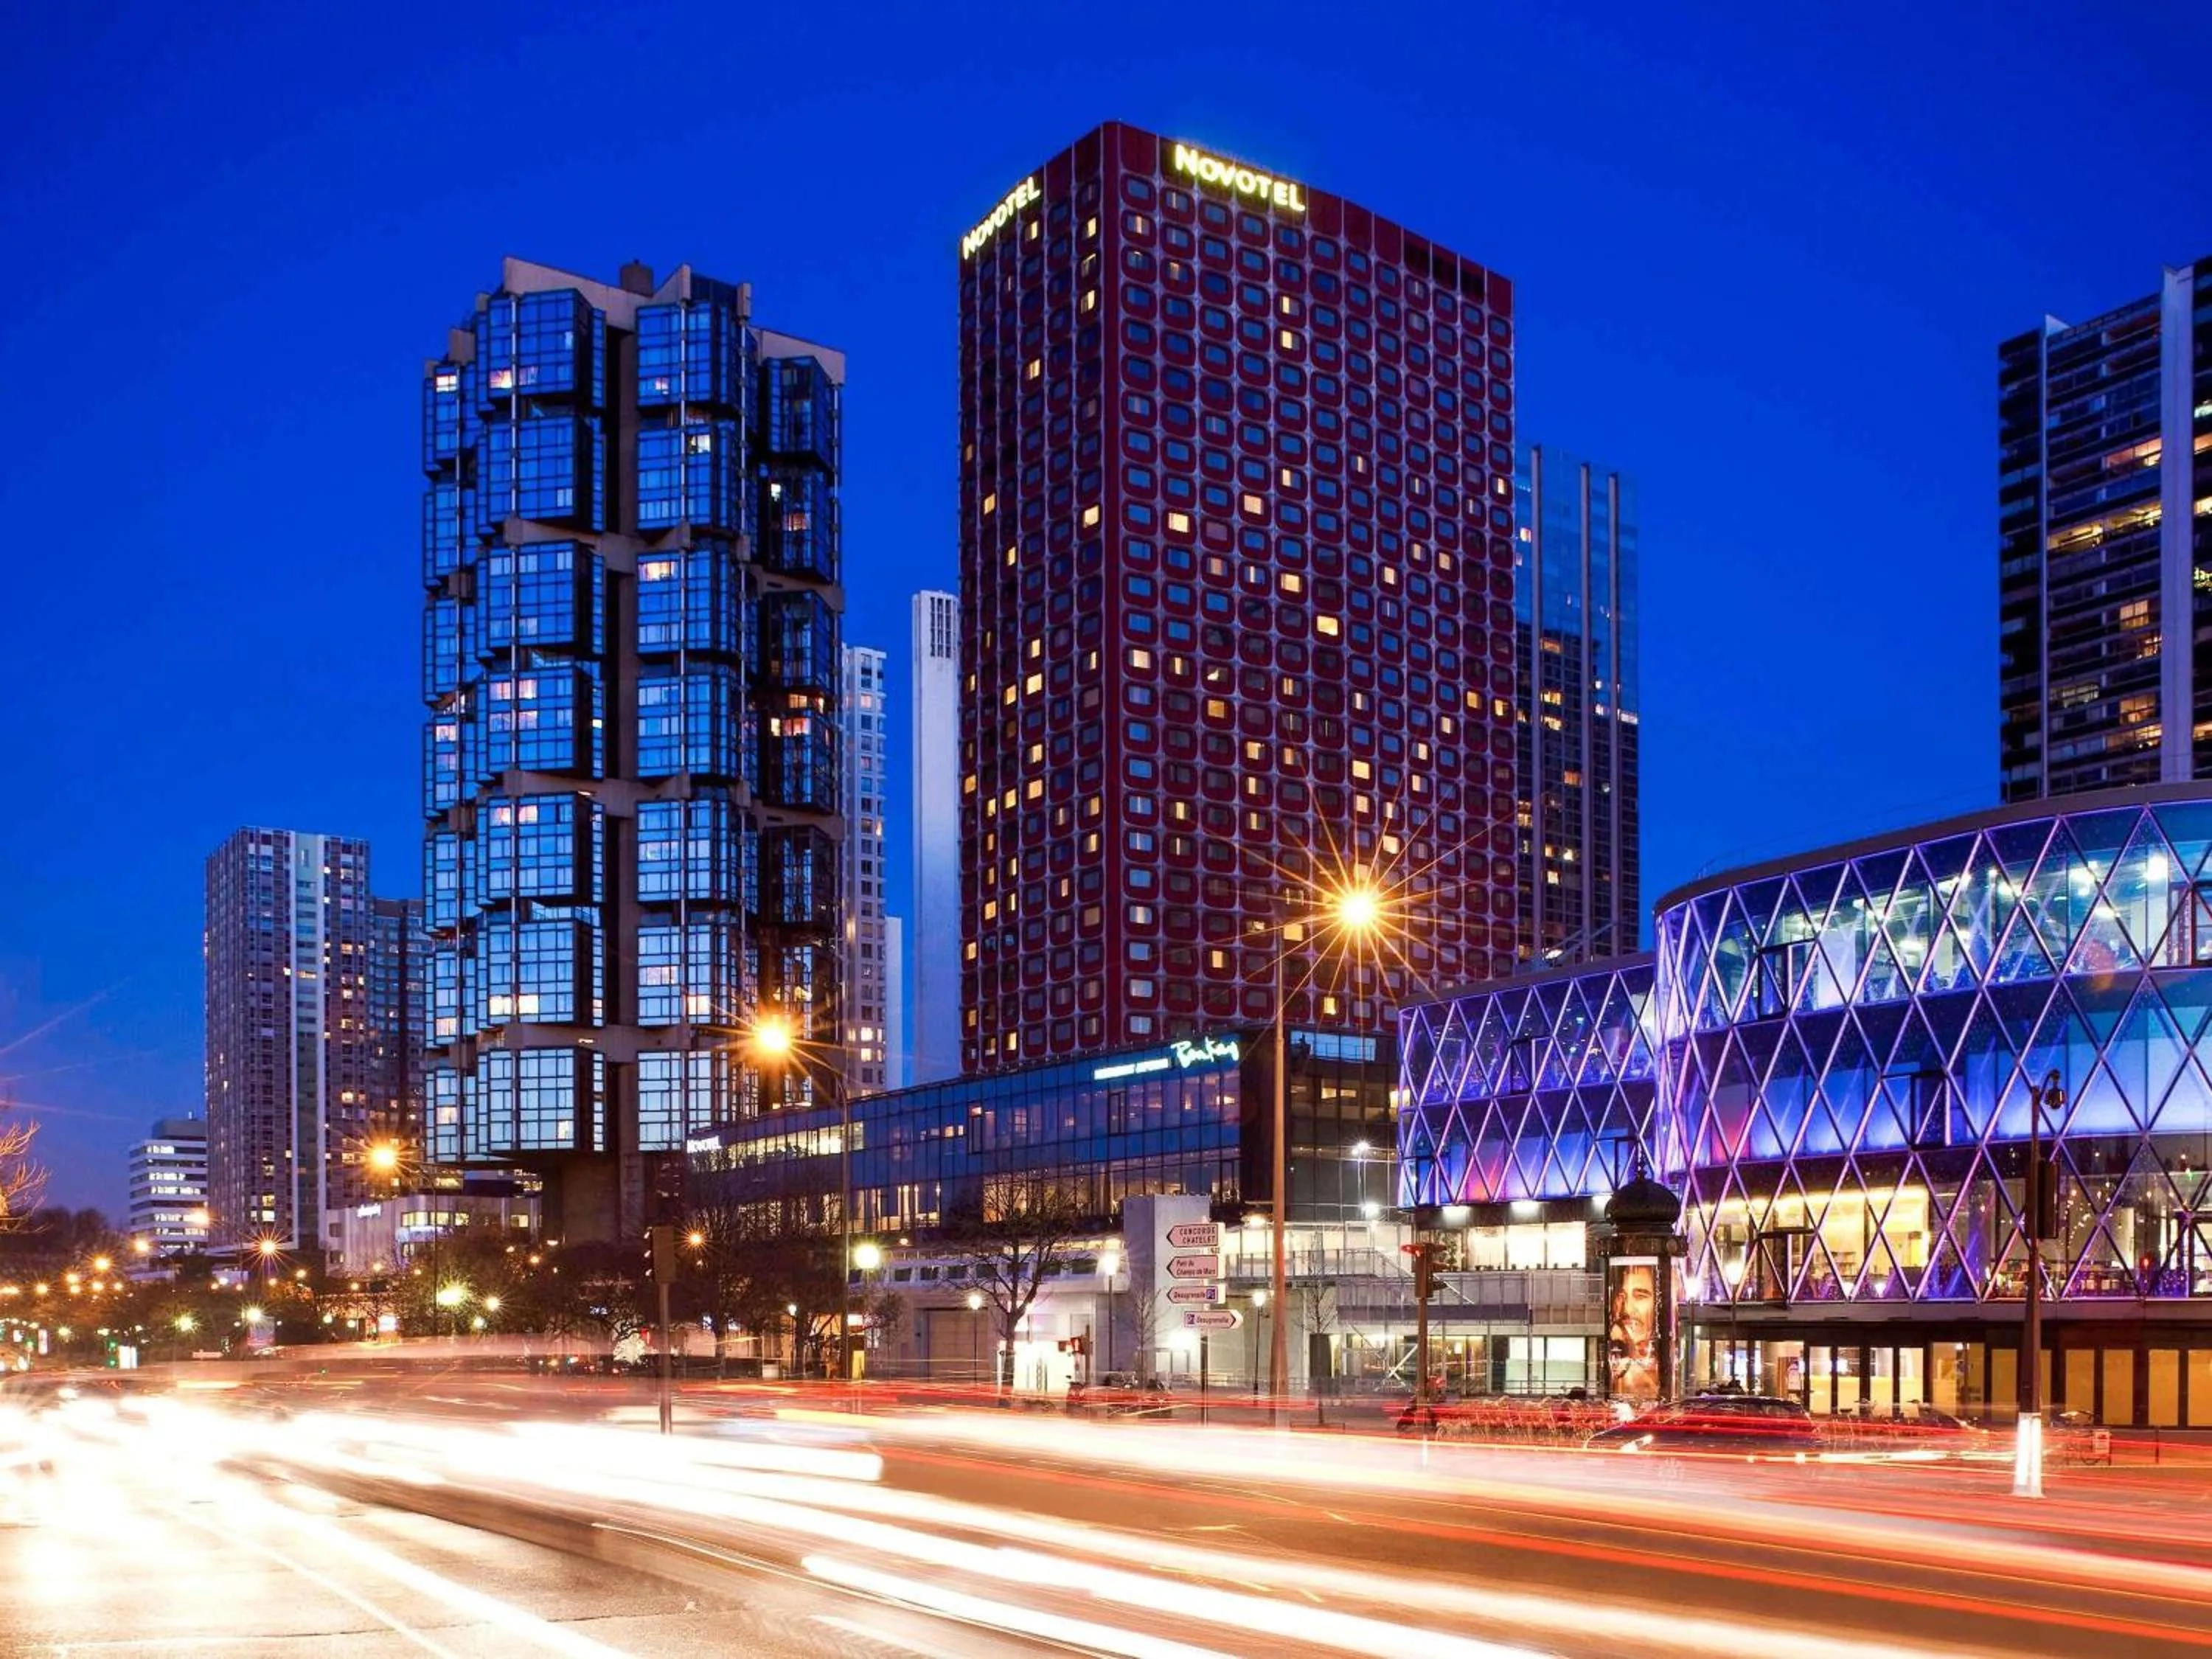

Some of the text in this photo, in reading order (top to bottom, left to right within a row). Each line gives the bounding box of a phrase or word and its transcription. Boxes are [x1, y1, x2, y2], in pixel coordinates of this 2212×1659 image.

[1175, 143, 1306, 212] NOVOTEL
[962, 176, 1041, 260] NOVOTEL
[1179, 1226, 1216, 1236] CONCORDE
